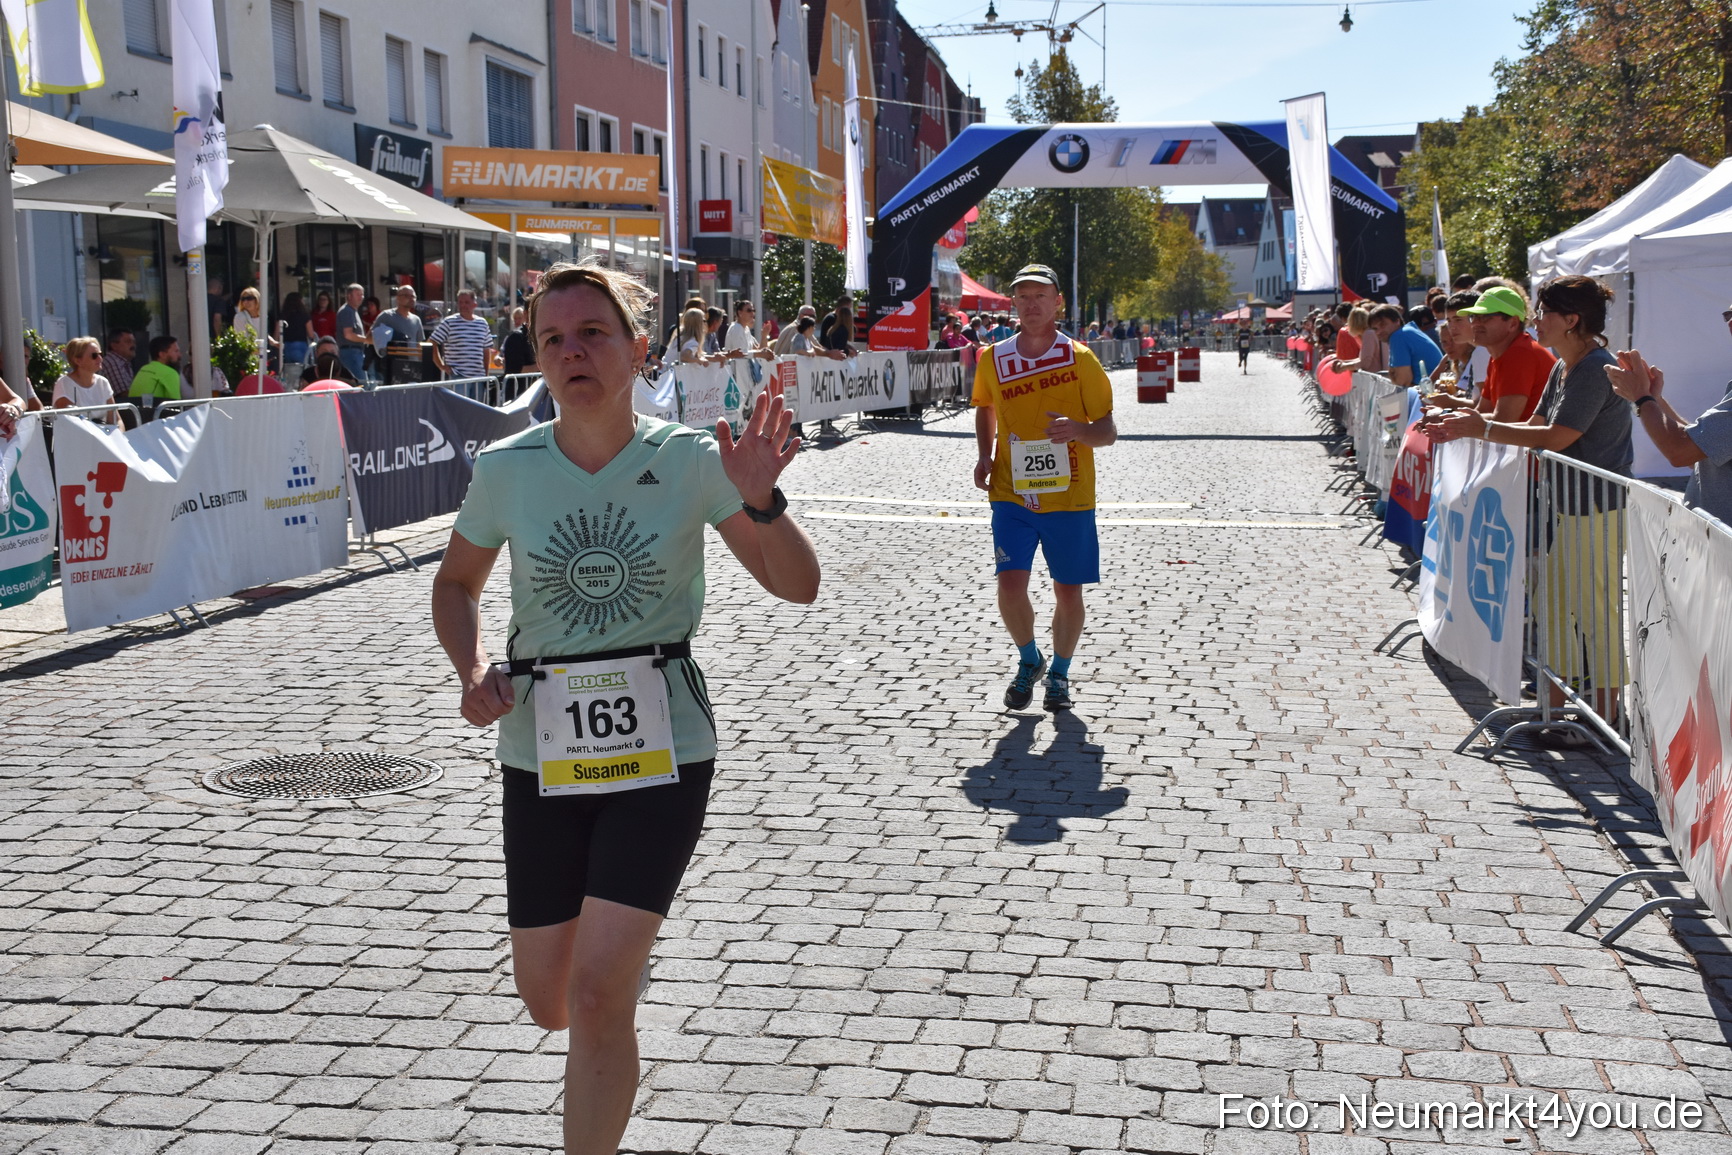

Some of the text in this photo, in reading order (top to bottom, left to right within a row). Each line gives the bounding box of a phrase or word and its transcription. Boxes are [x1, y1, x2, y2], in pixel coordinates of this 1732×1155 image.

[370, 134, 432, 188] frühauf
[450, 160, 648, 192] RUNMARKT.DE
[890, 165, 981, 228] PARTL NEUMARKT
[1330, 184, 1385, 220] EUMARKT
[525, 218, 603, 231] RUNMARKT.DE
[703, 210, 726, 219] WITT
[1001, 371, 1079, 400] MAX BÖGL
[350, 443, 426, 476] RAIL.ONE
[1024, 454, 1056, 472] 256
[1028, 480, 1057, 488] Andreas
[17, 536, 39, 548] Service
[579, 515, 592, 548] FINISHER
[65, 535, 105, 561] DKMS
[70, 562, 154, 586] JEDER EINZELNE ZÄHLT
[578, 565, 616, 575] BERLIN
[586, 579, 610, 588] 2015
[568, 671, 628, 690] BOCK
[565, 696, 638, 739] 163
[566, 742, 633, 754] PARTL Neumarkt
[573, 761, 640, 780] Susanne
